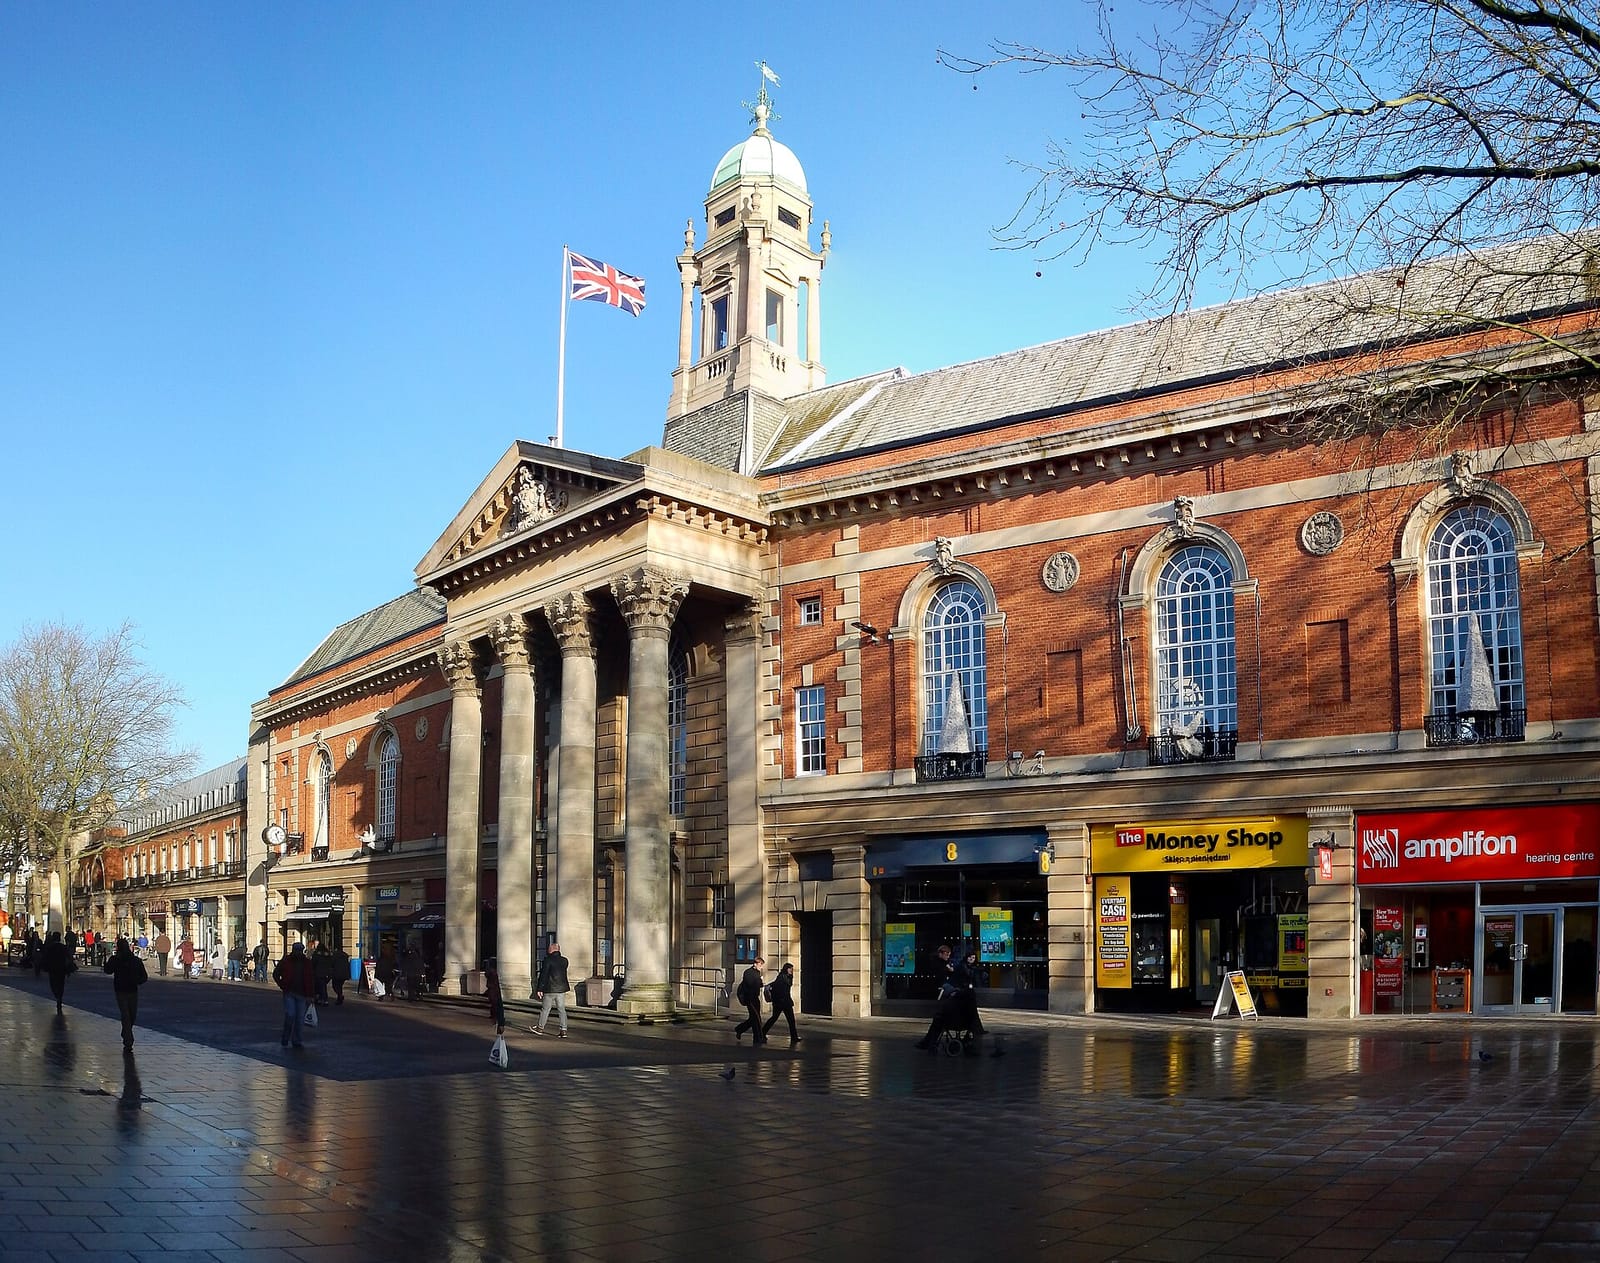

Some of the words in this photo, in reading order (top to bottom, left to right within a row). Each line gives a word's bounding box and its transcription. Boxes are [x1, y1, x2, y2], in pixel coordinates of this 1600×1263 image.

[1118, 832, 1142, 844] The
[1146, 832, 1220, 852] Money
[1226, 828, 1283, 850] Shop
[1404, 830, 1517, 863] amplifon
[1526, 853, 1560, 864] hearing
[1563, 851, 1595, 862] centre
[1102, 905, 1125, 916] CASH
